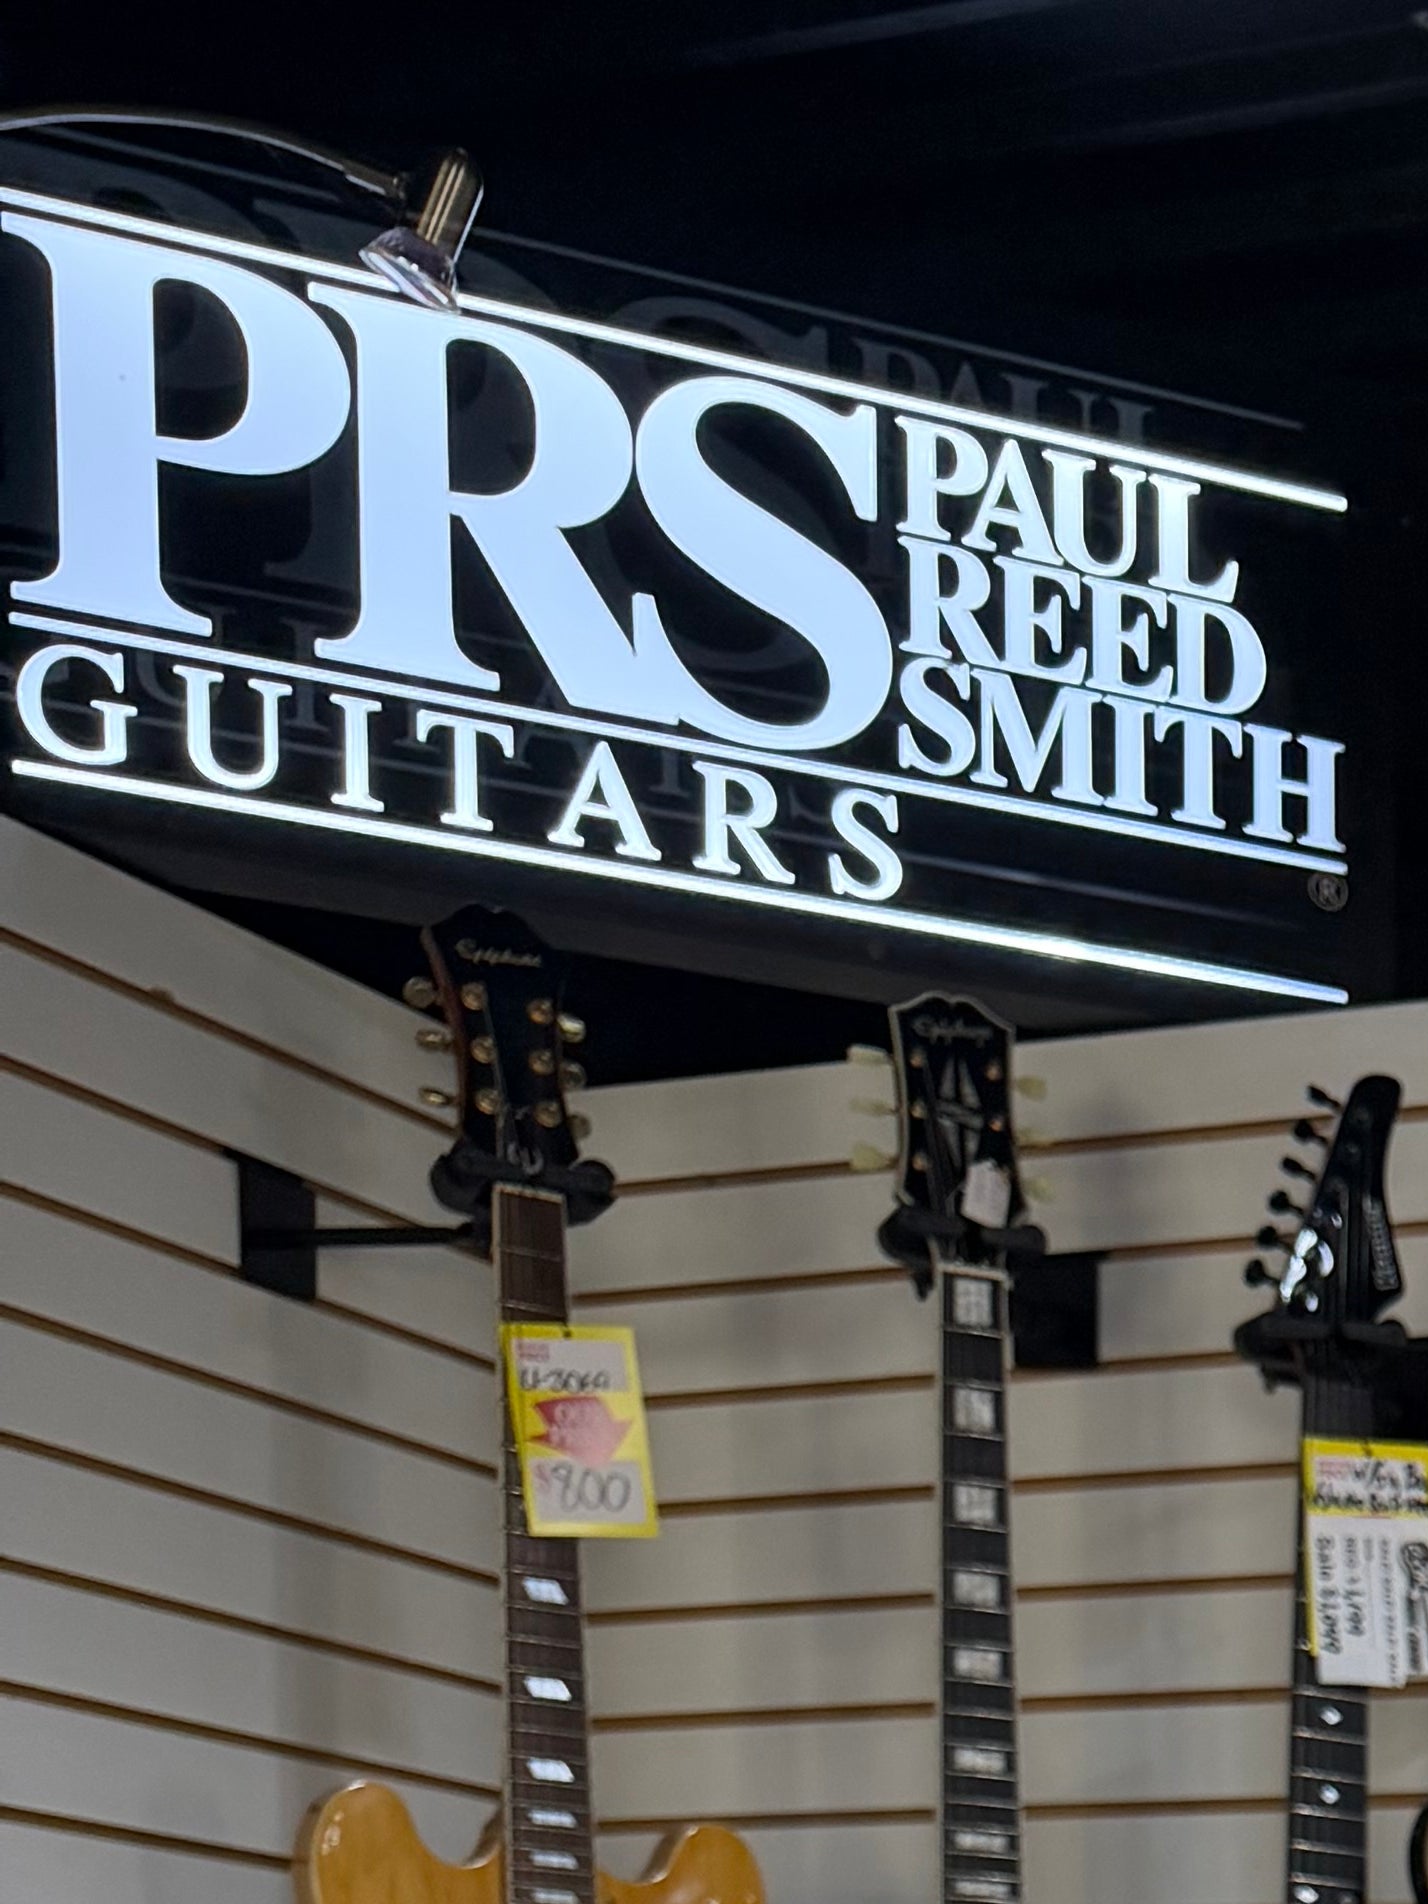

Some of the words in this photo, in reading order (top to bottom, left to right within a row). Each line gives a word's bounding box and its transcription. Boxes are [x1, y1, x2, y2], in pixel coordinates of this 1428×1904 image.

[0, 213, 892, 750] PRS
[894, 415, 1239, 602] PAUL
[898, 534, 1268, 716] REED
[15, 646, 905, 903] GUITARS
[896, 659, 1345, 855] SMITH
